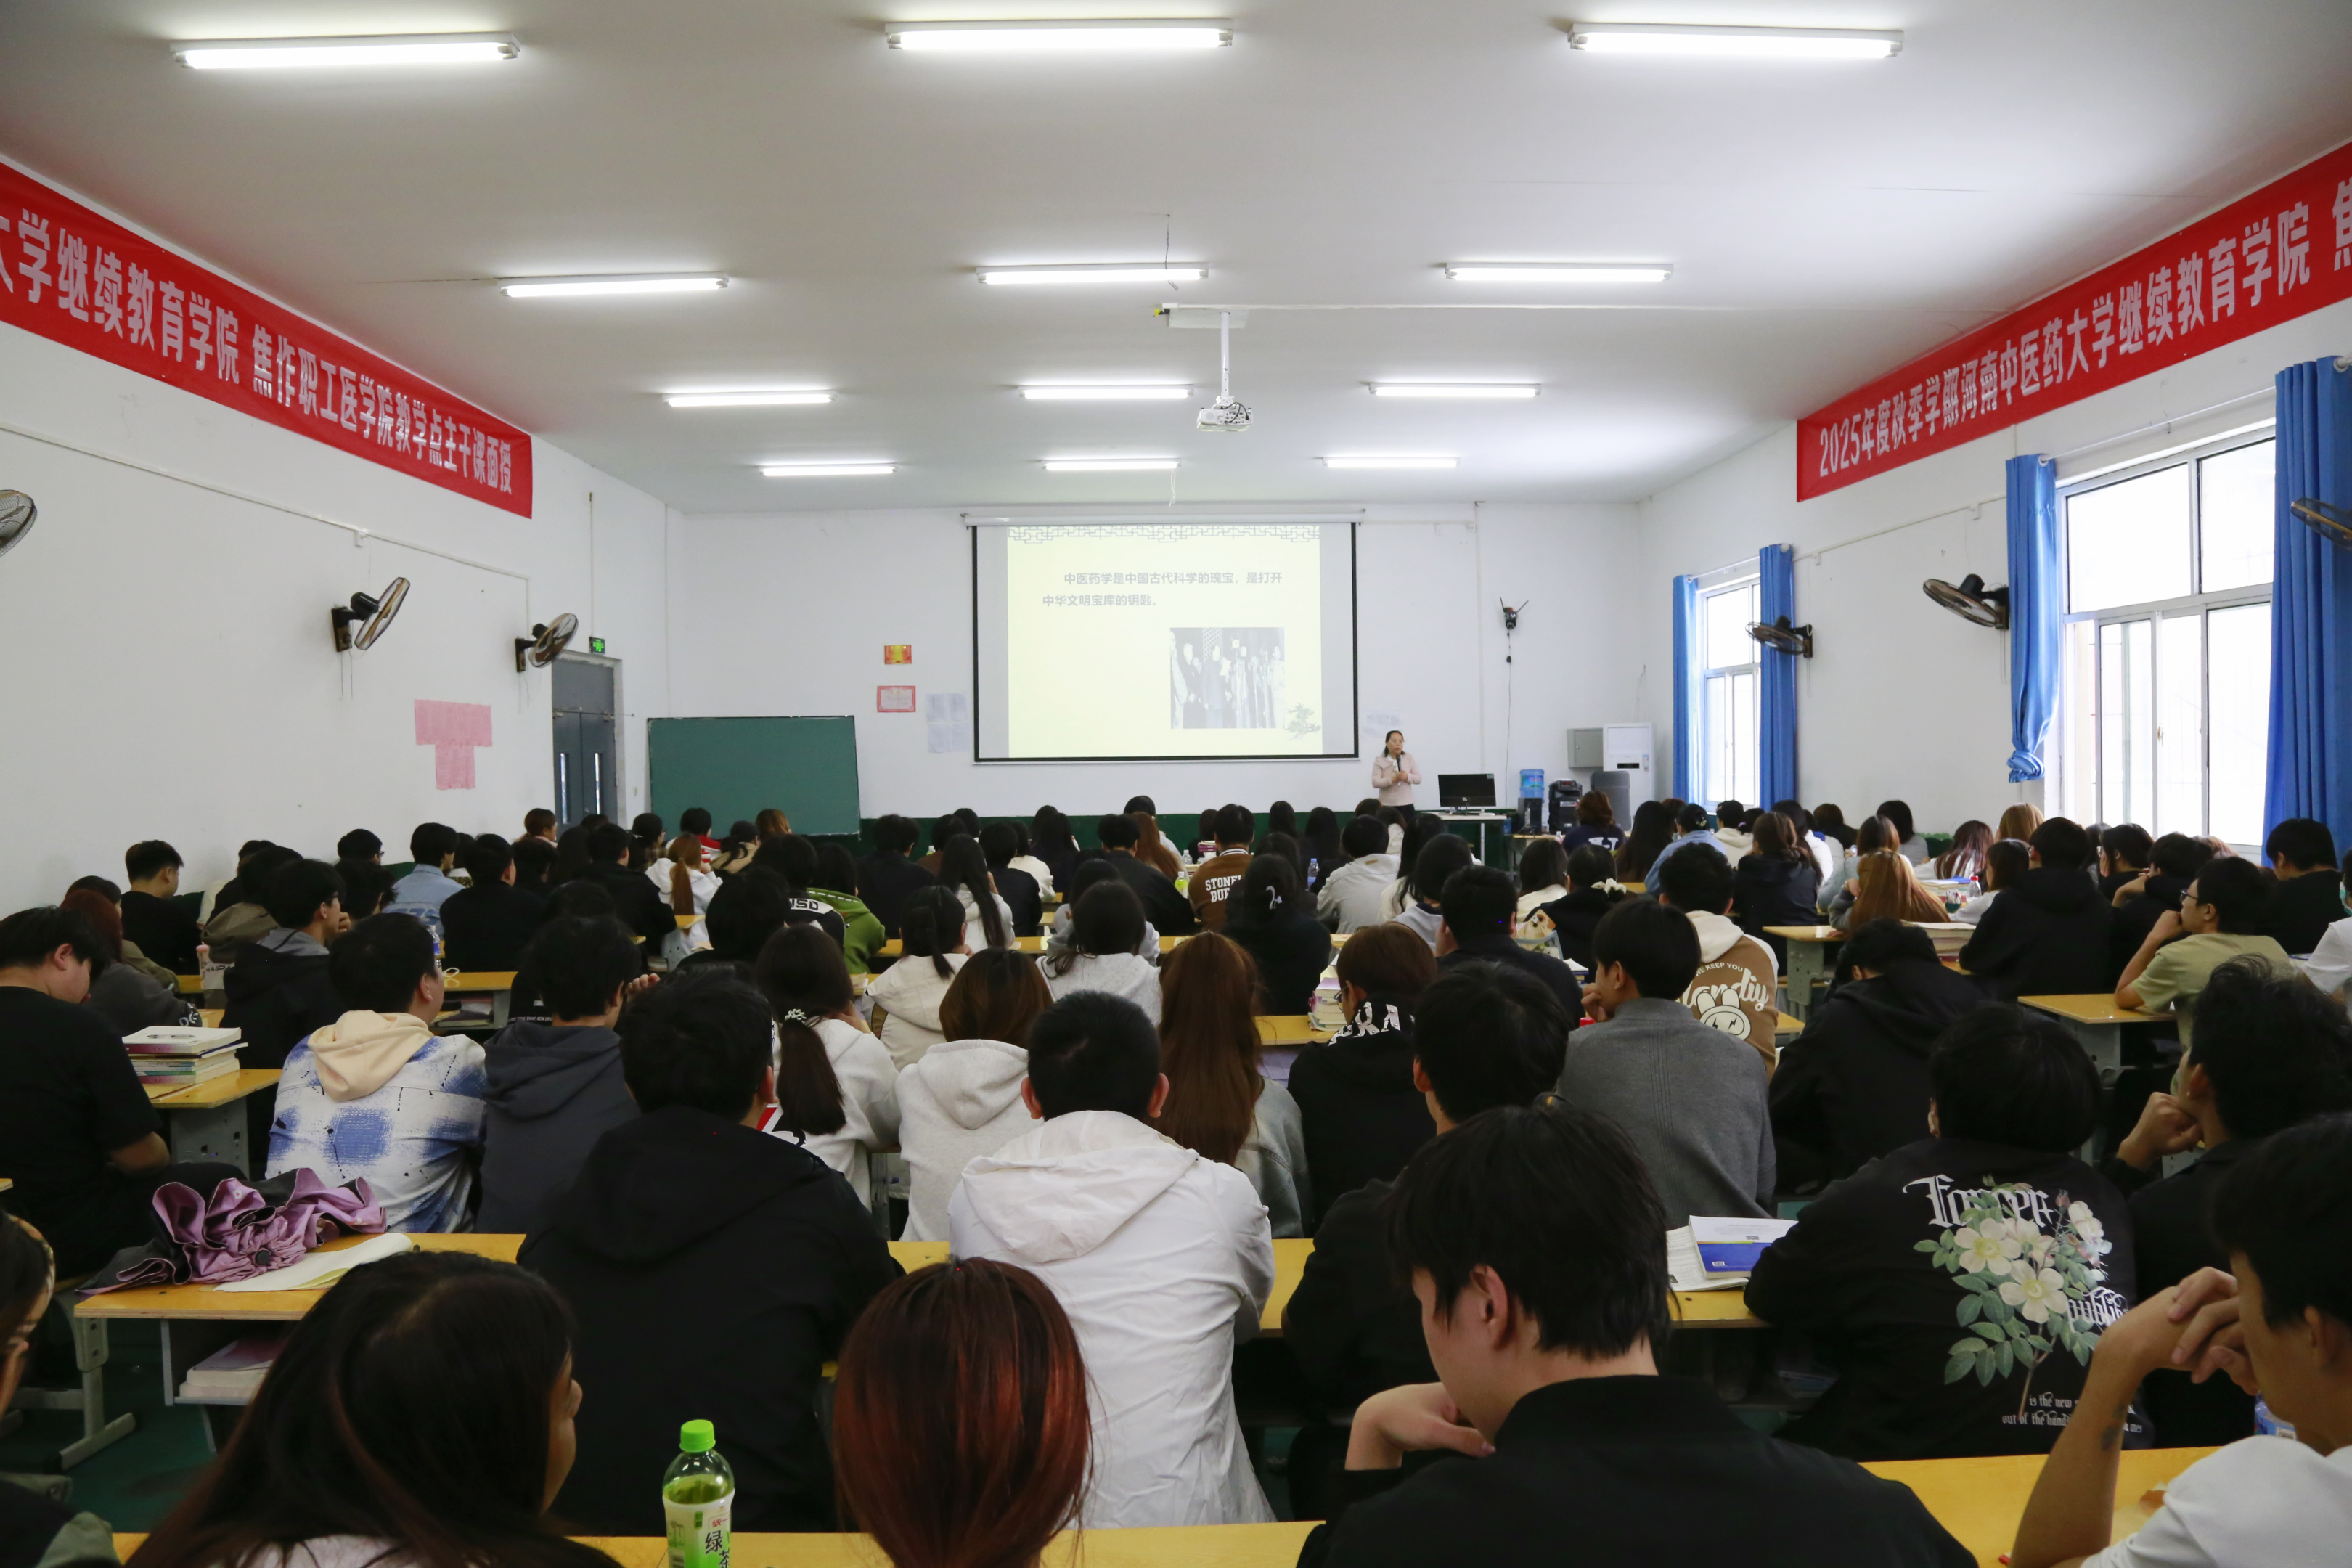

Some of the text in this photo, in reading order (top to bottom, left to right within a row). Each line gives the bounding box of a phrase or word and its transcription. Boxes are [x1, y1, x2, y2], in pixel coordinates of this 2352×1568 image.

[1819, 200, 2311, 478] 2025年度秋季学期河南中医药大学继续教育学院
[252, 323, 512, 495] 焦作职工医学院教学点主干课面授
[1063, 571, 1283, 585] 中医药学是中国古代科学的瑰宝，是打开
[1042, 594, 1157, 607] 中华文明宝库的钥匙。
[1705, 962, 1725, 971] KEEP
[1727, 963, 1744, 972] YOU
[2029, 1395, 2037, 1407] is
[2038, 1392, 2054, 1408] the
[2055, 1398, 2072, 1408] new
[2002, 1414, 2017, 1424] out
[2020, 1413, 2028, 1424] of
[2031, 1410, 2045, 1426] the
